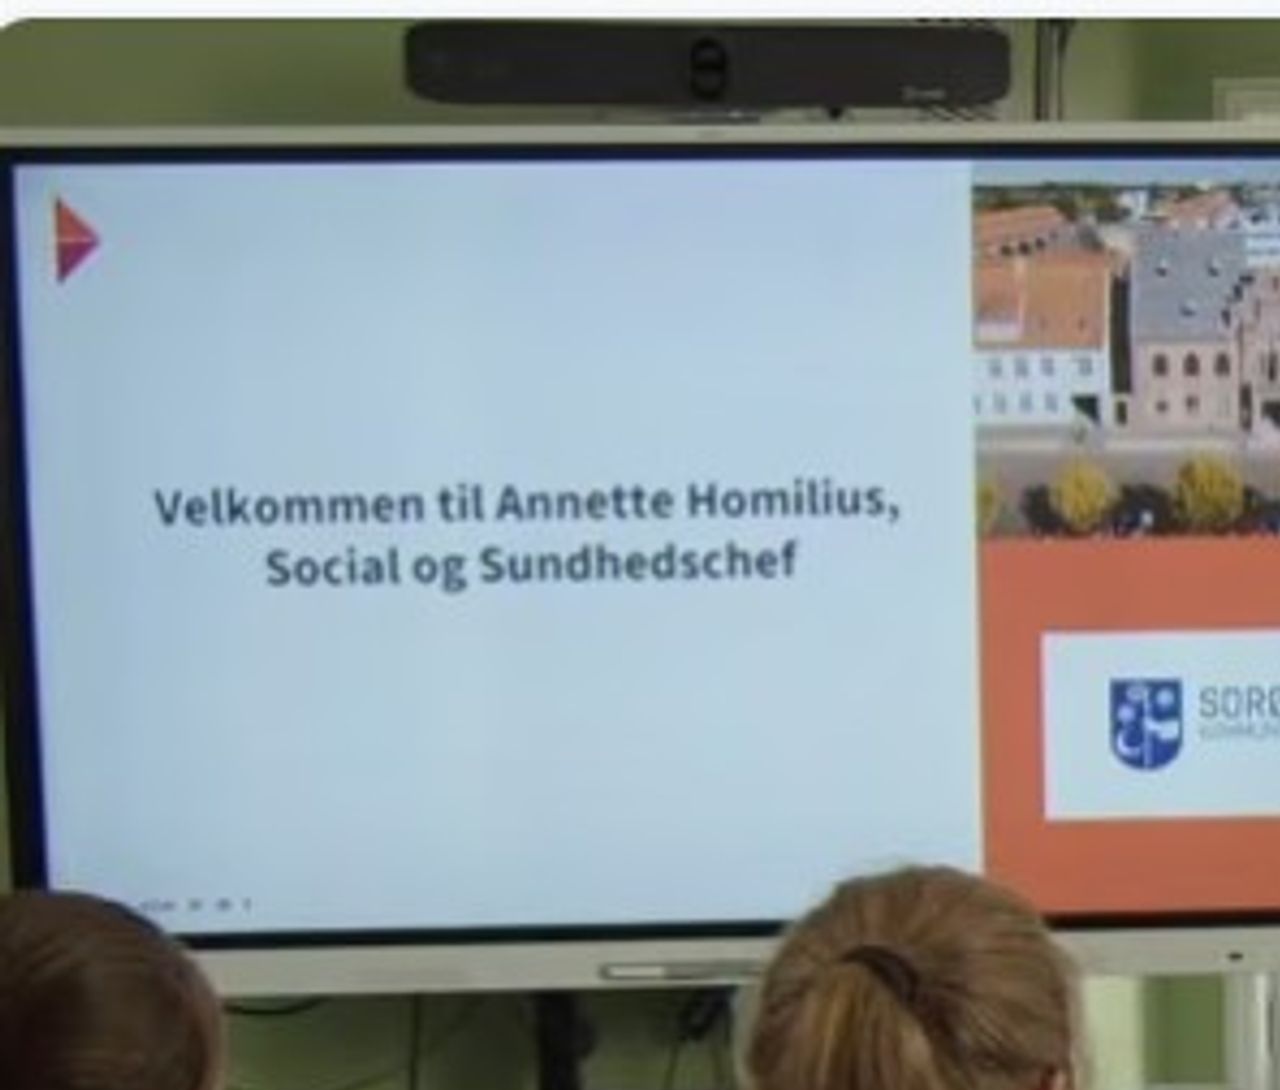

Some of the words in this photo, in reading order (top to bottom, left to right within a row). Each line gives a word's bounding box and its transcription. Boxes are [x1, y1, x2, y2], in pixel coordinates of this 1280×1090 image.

[154, 488, 426, 526] Velkommen
[437, 483, 484, 523] til
[497, 484, 675, 522] Annette
[689, 478, 900, 524] Homilius,
[266, 546, 401, 588] Social
[412, 553, 468, 594] og
[482, 538, 797, 583] Sundhedschef
